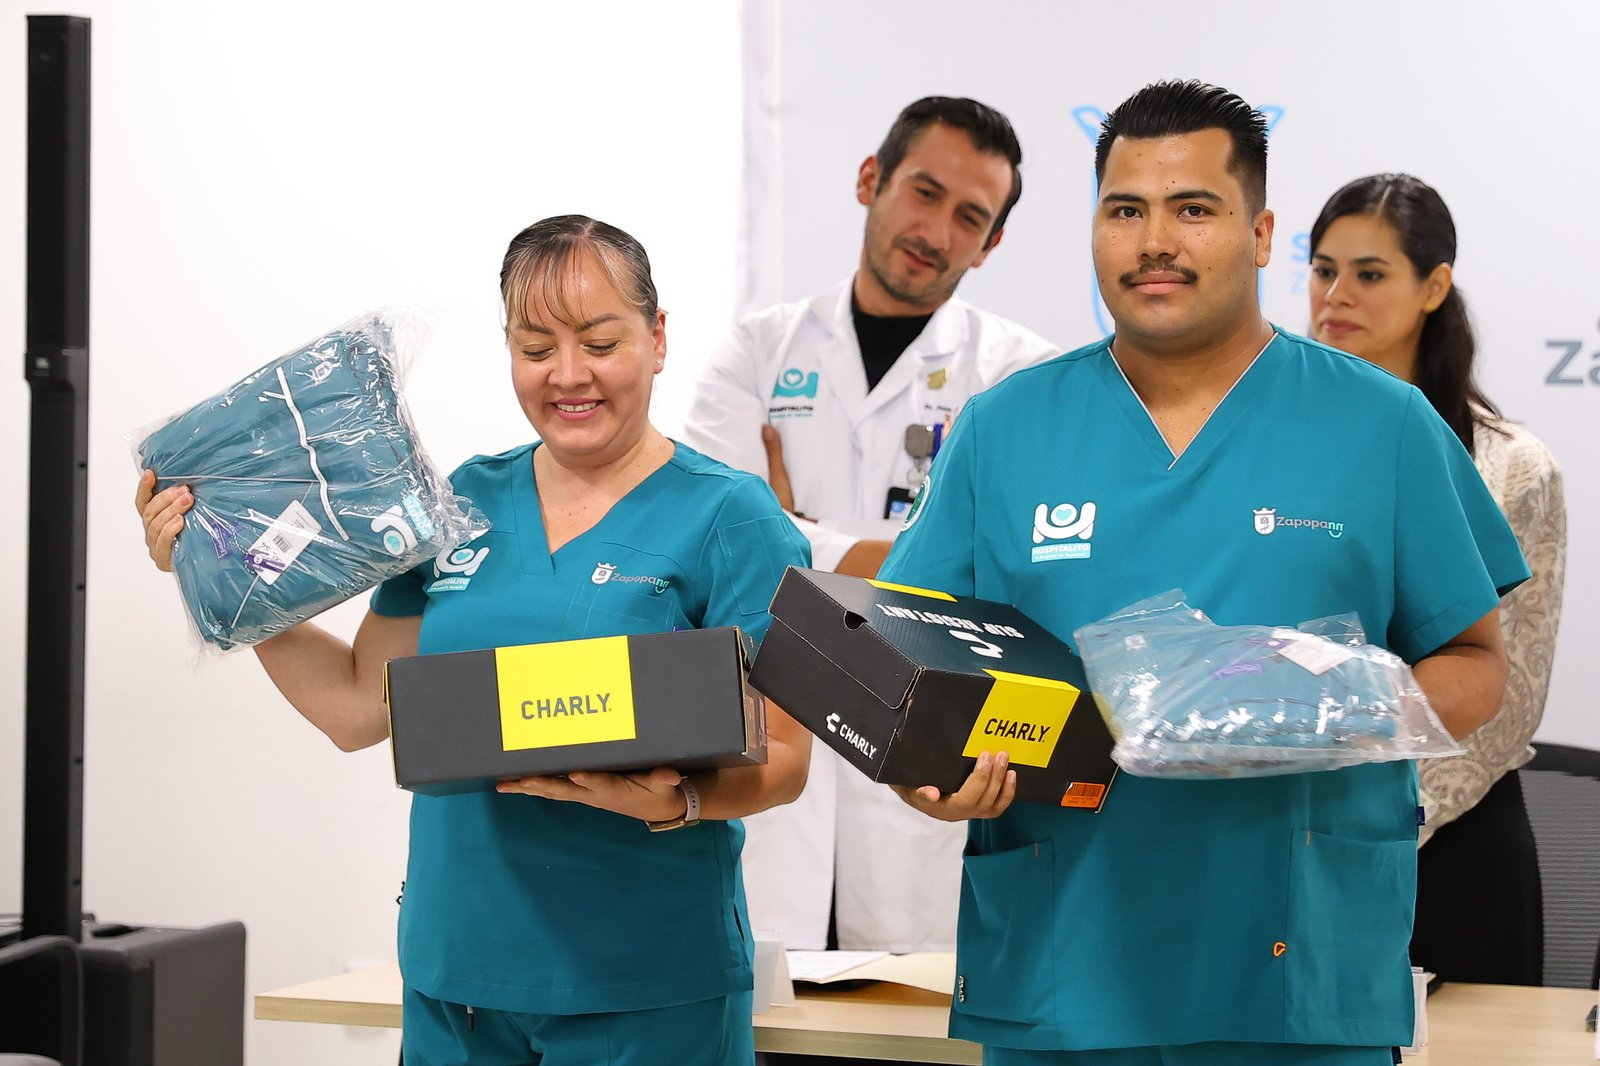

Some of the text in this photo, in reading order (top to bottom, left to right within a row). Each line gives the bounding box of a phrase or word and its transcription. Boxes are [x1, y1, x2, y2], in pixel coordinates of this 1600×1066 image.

[1033, 544, 1089, 556] HOSPITALITO
[982, 622, 1025, 639] SLIP
[521, 693, 611, 720] CHARLY
[839, 724, 877, 758] CHARLY
[984, 718, 1051, 742] CHARLY
